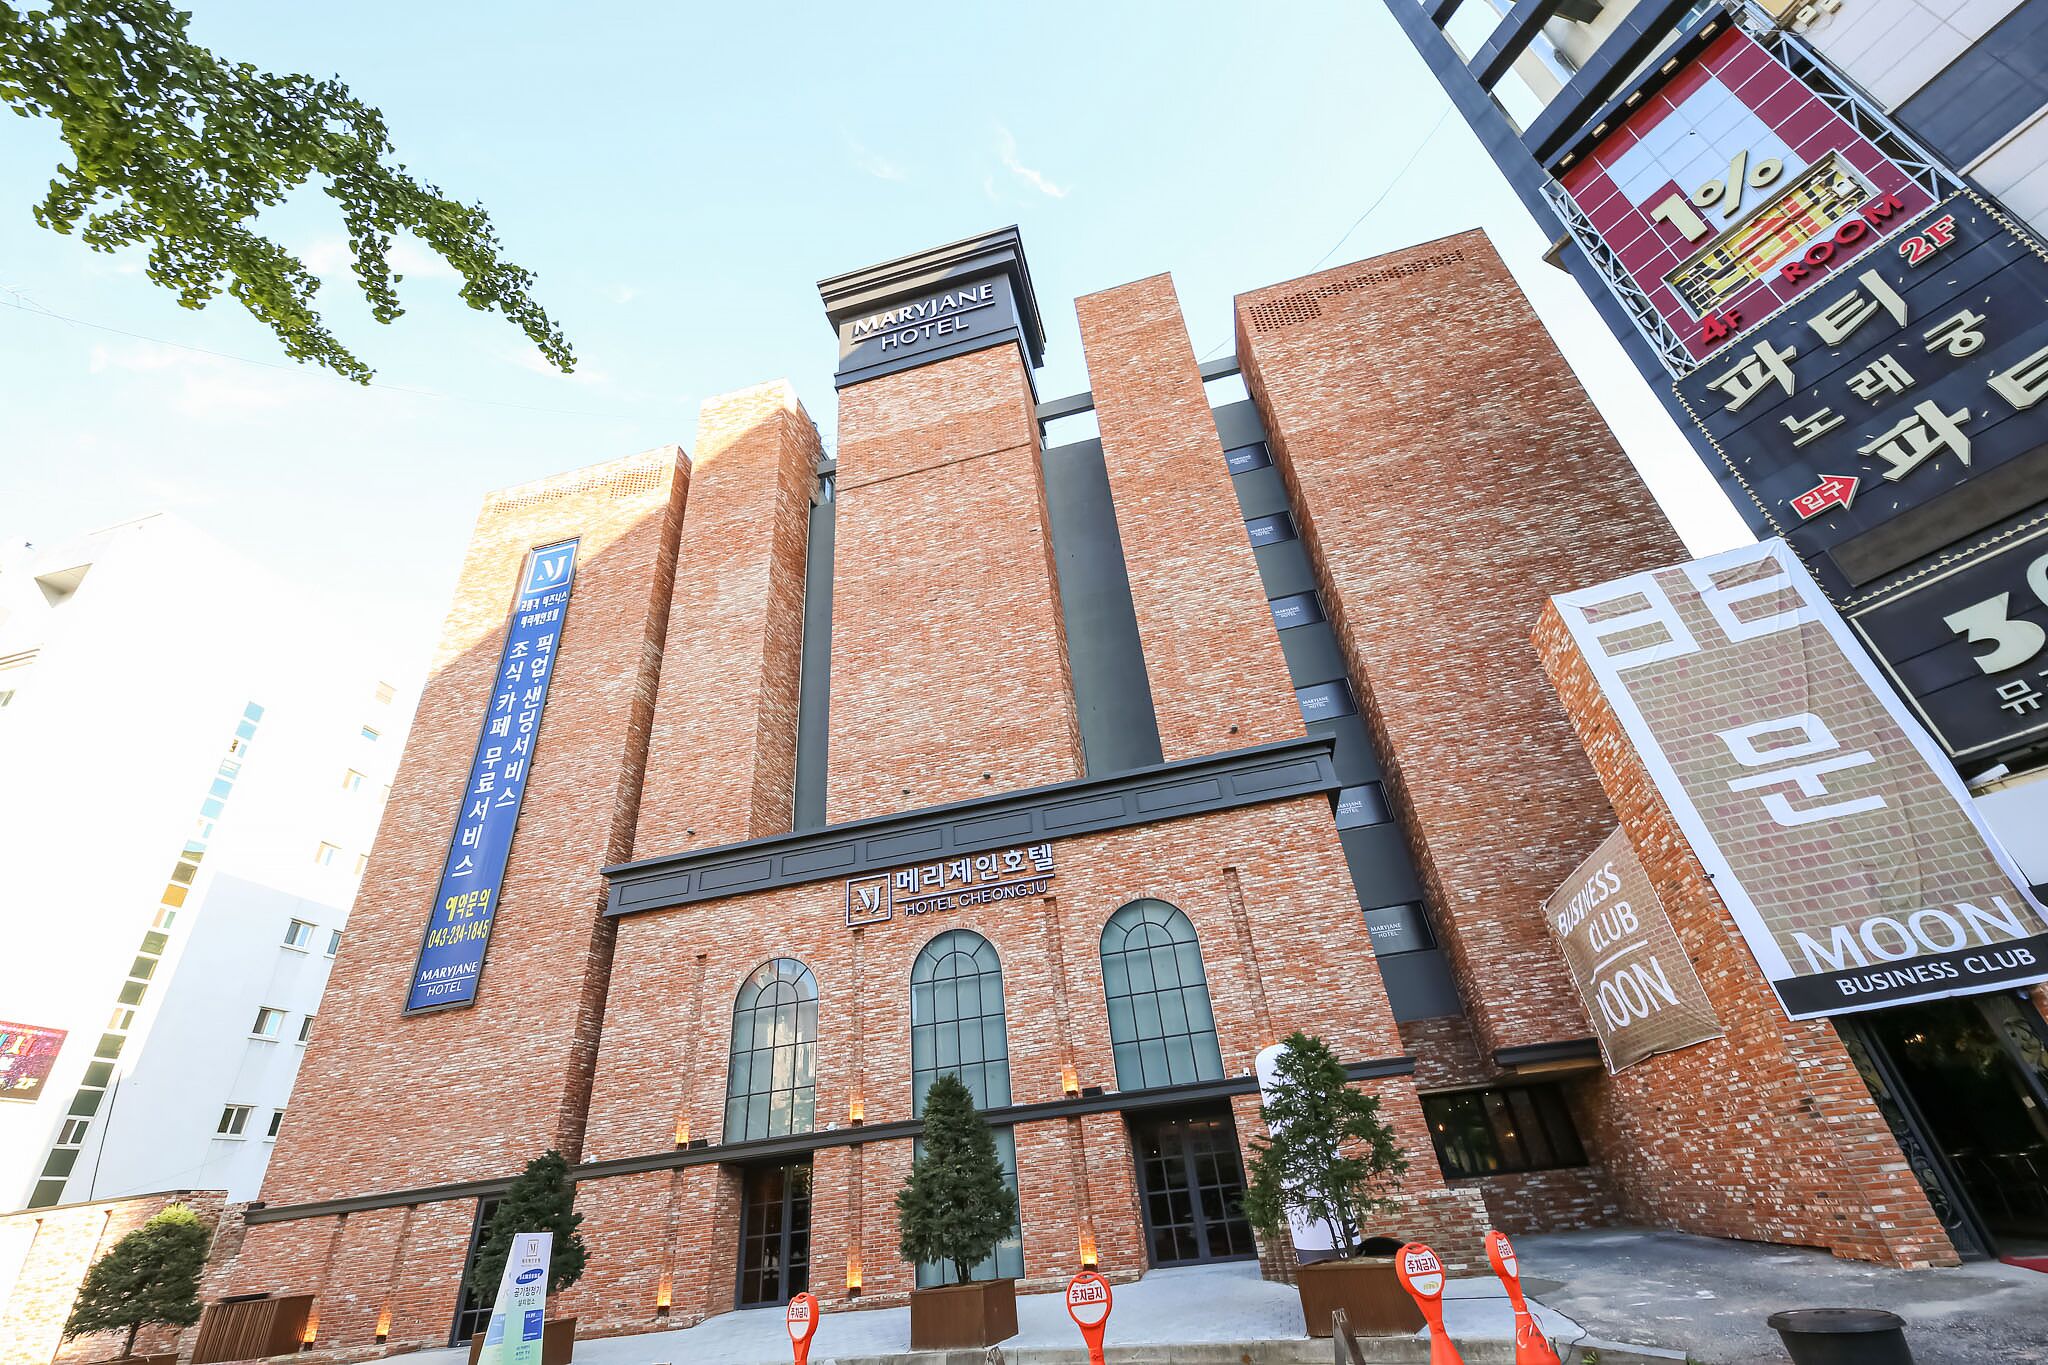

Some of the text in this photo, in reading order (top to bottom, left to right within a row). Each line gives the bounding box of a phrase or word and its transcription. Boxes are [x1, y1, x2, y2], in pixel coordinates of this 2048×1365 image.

[1650, 149, 1783, 243] 1%
[1899, 214, 1957, 267] 2F
[1702, 194, 1904, 345] 4F ROOM
[853, 282, 994, 336] MARYJANE
[881, 316, 969, 351] HOTEL
[1706, 269, 1908, 413] 파티
[1801, 481, 1844, 510] 입구
[1715, 712, 1888, 827] 문
[451, 746, 502, 878] 무료서비스
[896, 843, 1056, 893] 메리제인호텔
[445, 888, 492, 922] 예약문의
[905, 879, 1048, 917] HOTEL CHEONGJU
[1558, 861, 1621, 938] BUSINESS
[428, 919, 491, 950] 043-234-1845
[1370, 923, 1401, 932] MARYJANE
[1378, 931, 1399, 939] HOTEL
[1588, 901, 1639, 953] CLUB
[1790, 896, 2030, 974] MOON
[419, 961, 479, 983] MARYJANE
[426, 982, 463, 997] HOTEL
[1836, 948, 2037, 996] BUSINESS CLUB
[1071, 1287, 1103, 1302] 주차금지
